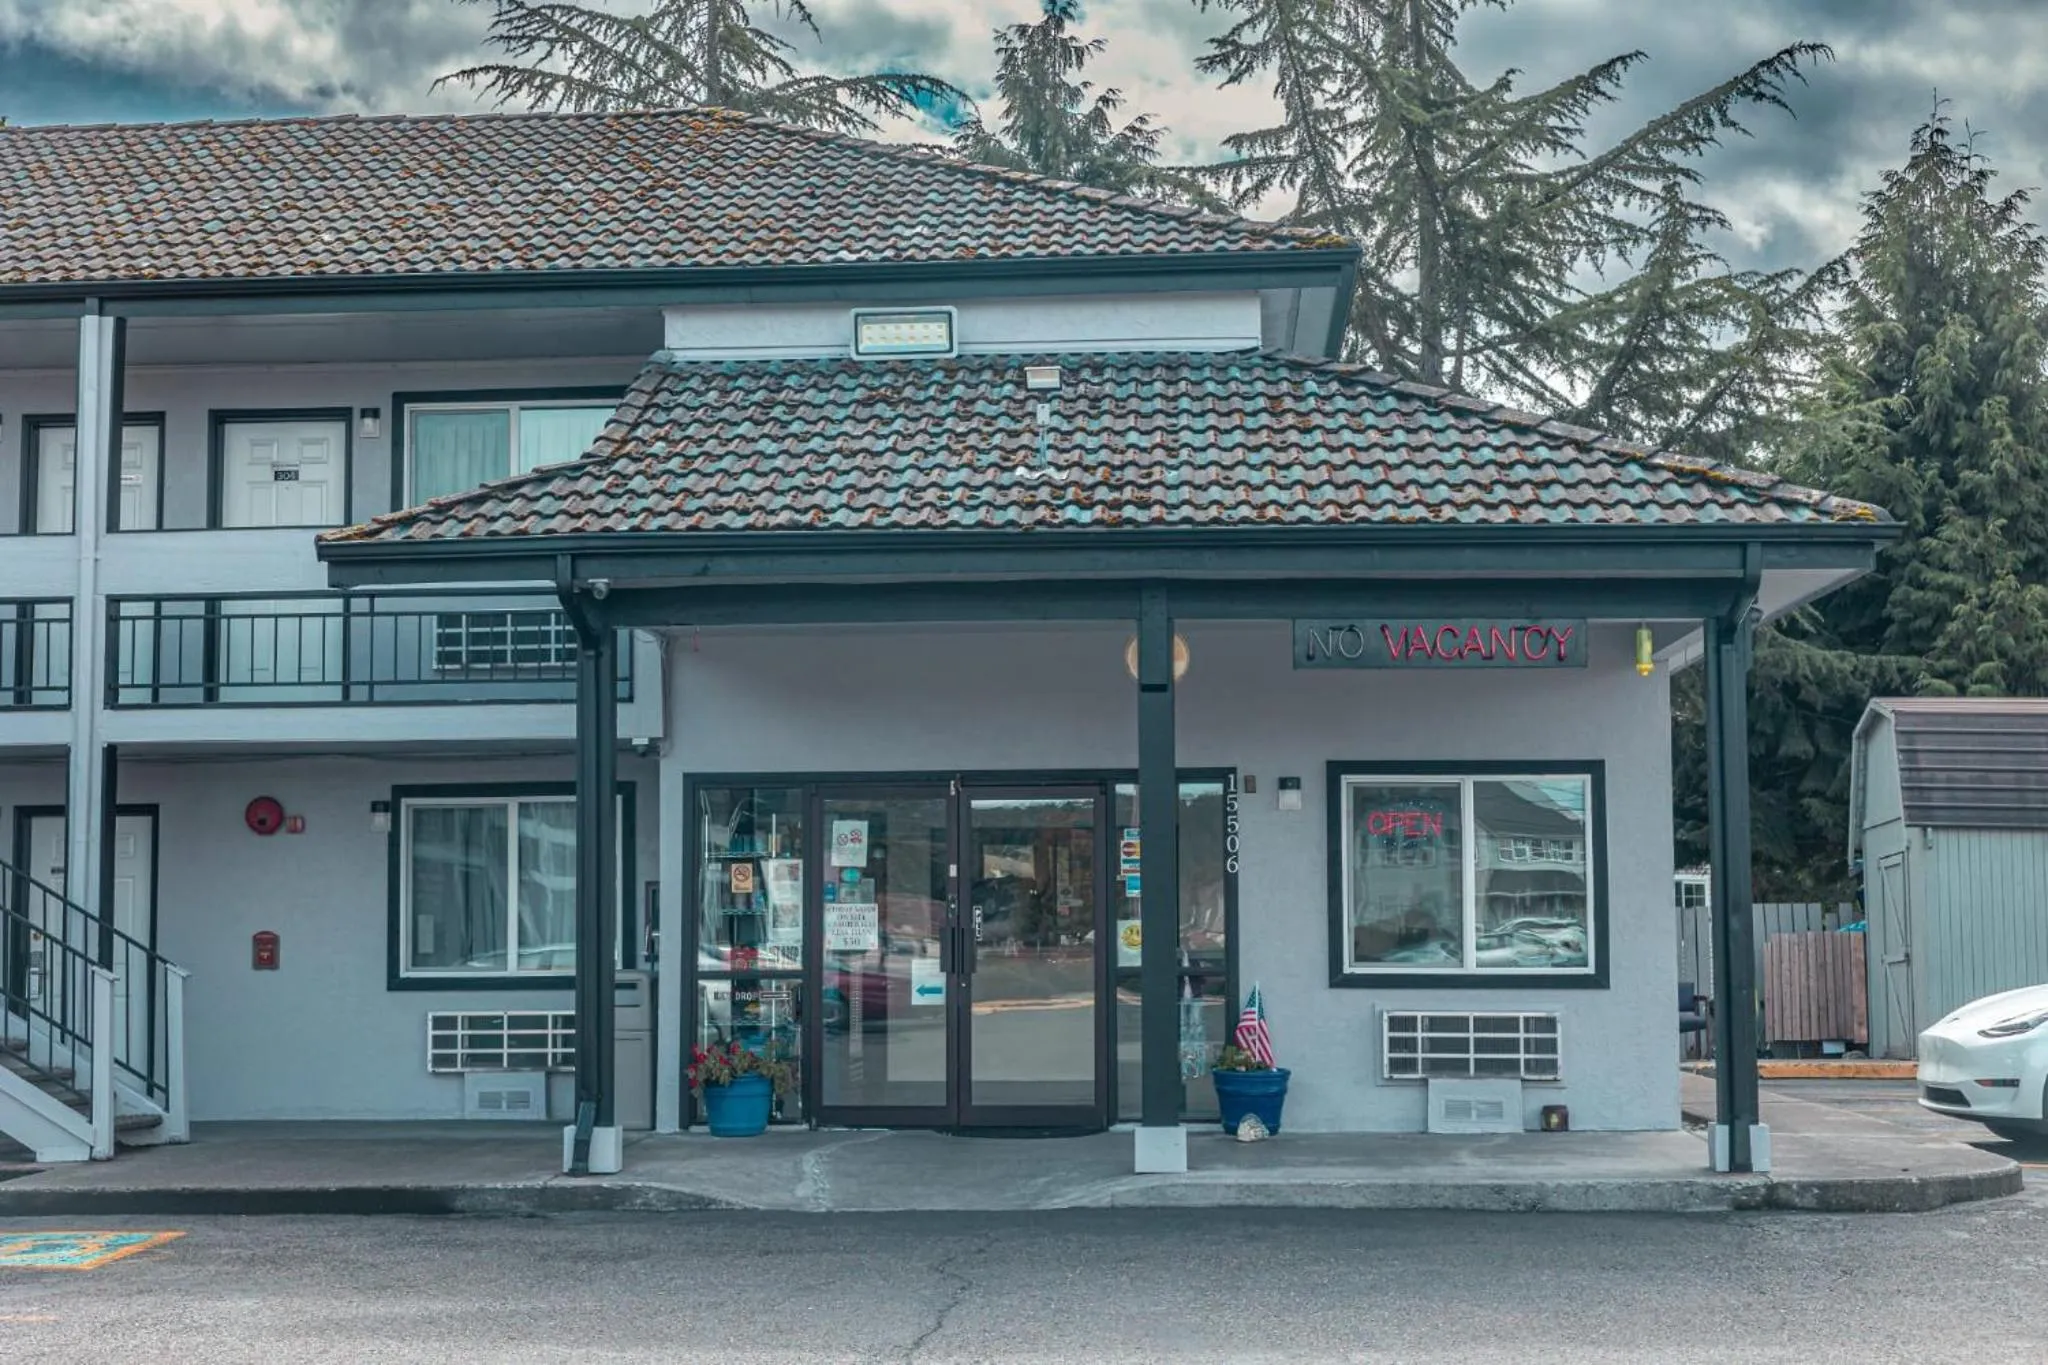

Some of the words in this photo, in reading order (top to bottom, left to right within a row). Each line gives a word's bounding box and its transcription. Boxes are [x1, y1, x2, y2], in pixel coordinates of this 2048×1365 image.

[1306, 624, 1364, 660] NO
[1380, 623, 1573, 662] VACANCY
[1226, 773, 1239, 873] 15506
[1366, 810, 1443, 837] OPEN
